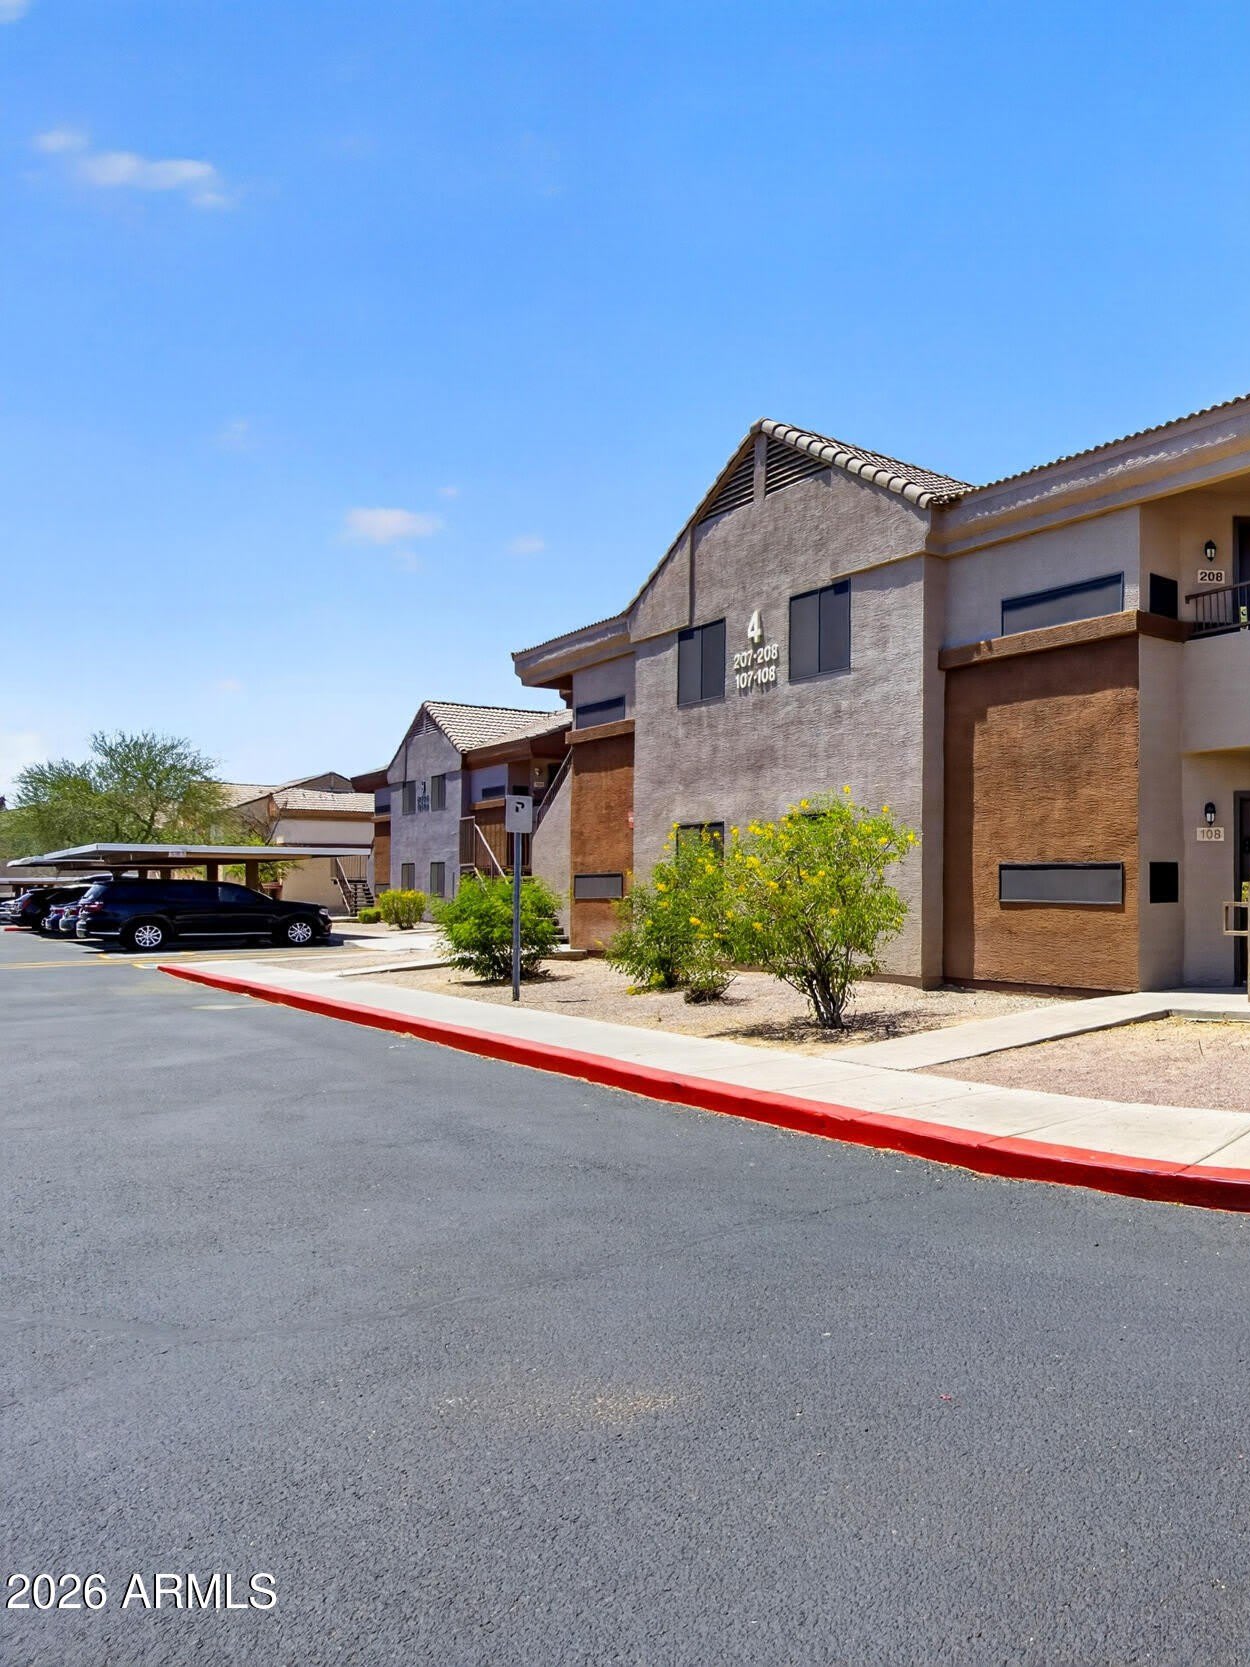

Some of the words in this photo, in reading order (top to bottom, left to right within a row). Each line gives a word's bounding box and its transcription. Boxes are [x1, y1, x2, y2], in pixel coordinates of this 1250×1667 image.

[1200, 571, 1223, 582] 208
[747, 610, 761, 643] 4
[1200, 829, 1221, 840] 108
